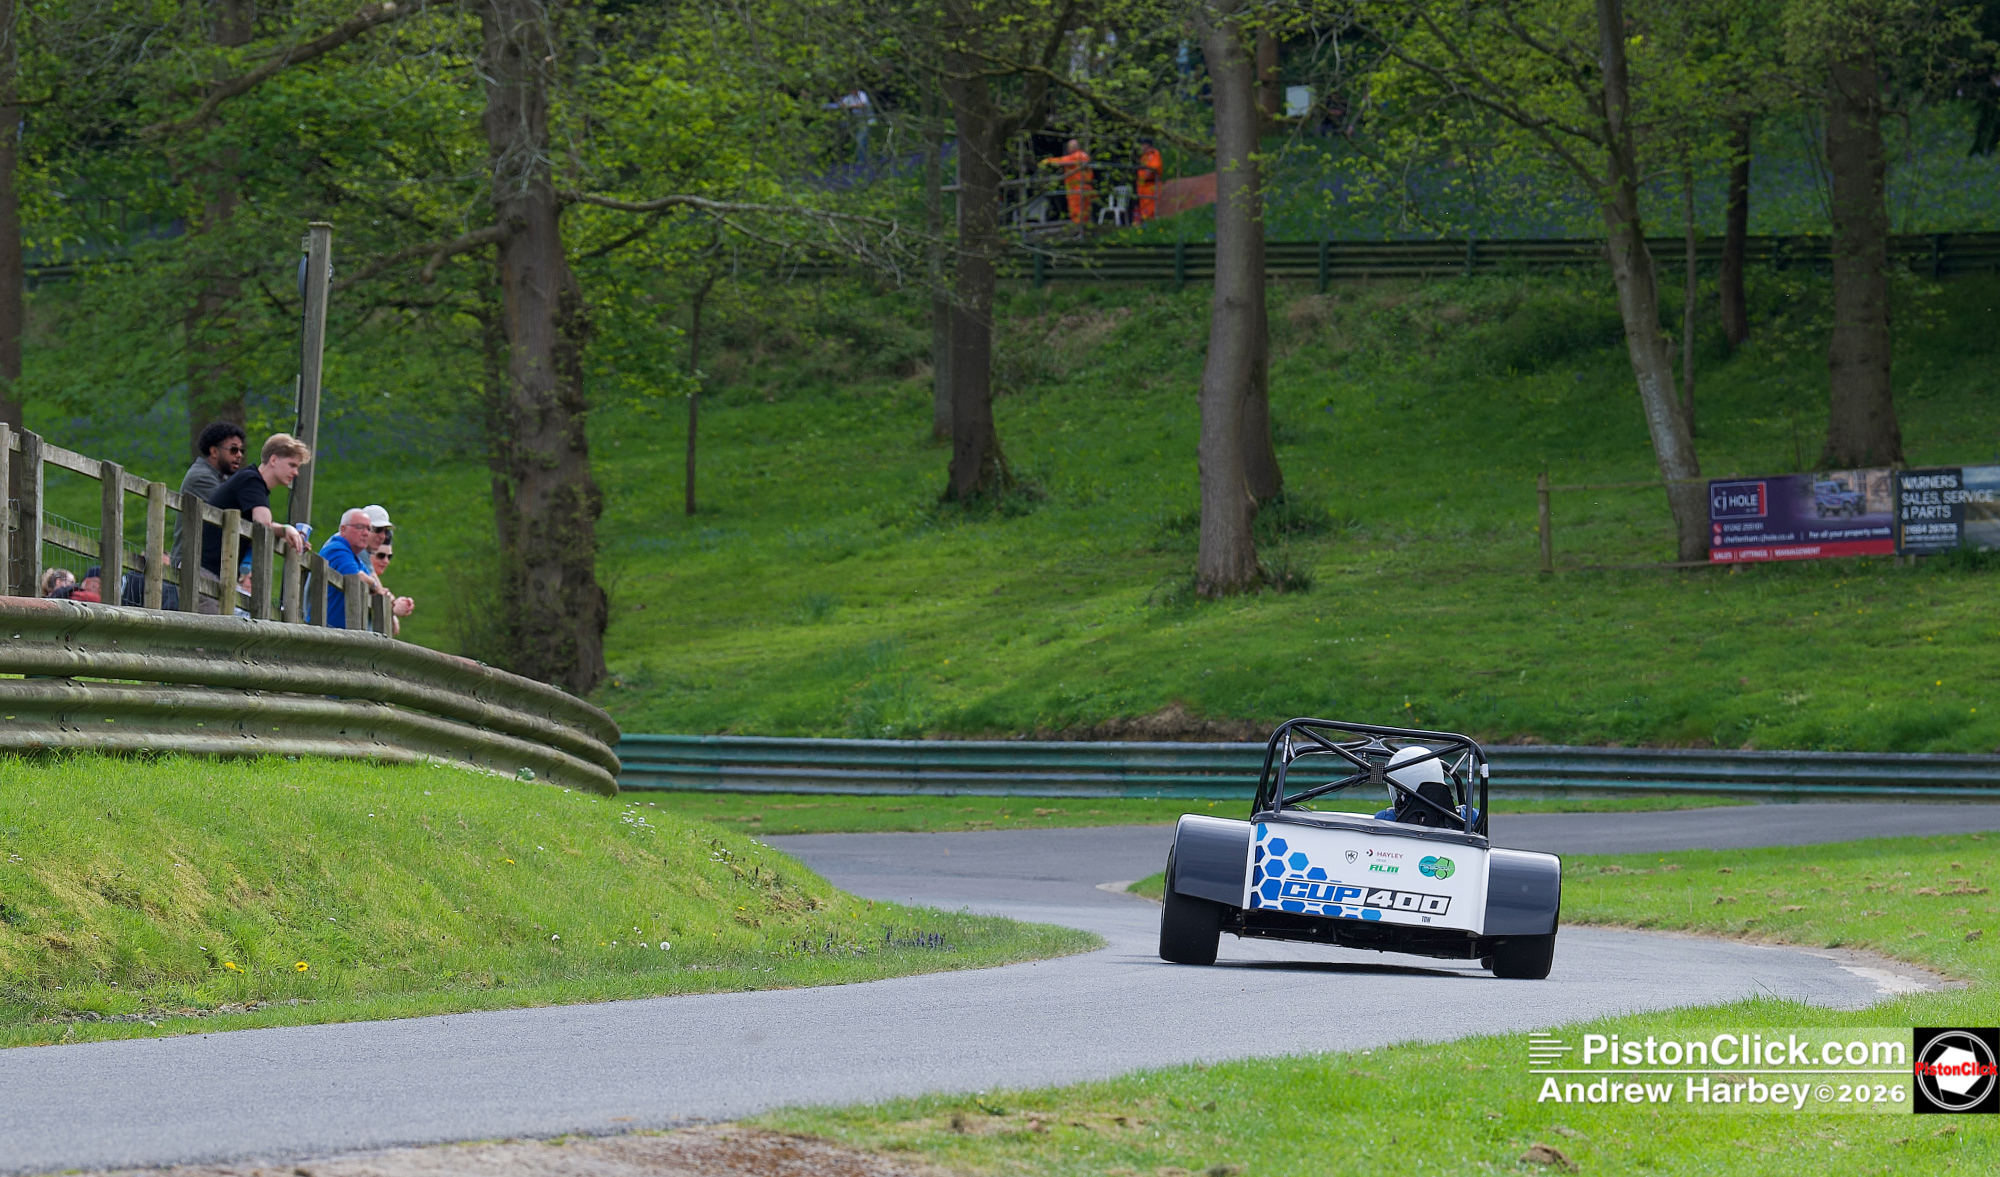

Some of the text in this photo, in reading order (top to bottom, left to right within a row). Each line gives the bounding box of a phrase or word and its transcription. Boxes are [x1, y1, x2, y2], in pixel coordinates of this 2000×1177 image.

[1901, 475, 1958, 489] WARNERS
[1729, 494, 1758, 507] HOLE
[1943, 489, 1993, 503] SERVICE
[1901, 505, 1952, 520] & PARTS
[1820, 530, 1829, 538] all
[1829, 531, 1843, 540] your
[1844, 529, 1871, 538] property
[1871, 526, 1891, 535] needs
[1713, 547, 1821, 560] SALES LETTINGS MANAGEMENT
[1376, 851, 1404, 859] HAYLEY
[1281, 881, 1449, 915] CUP 400
